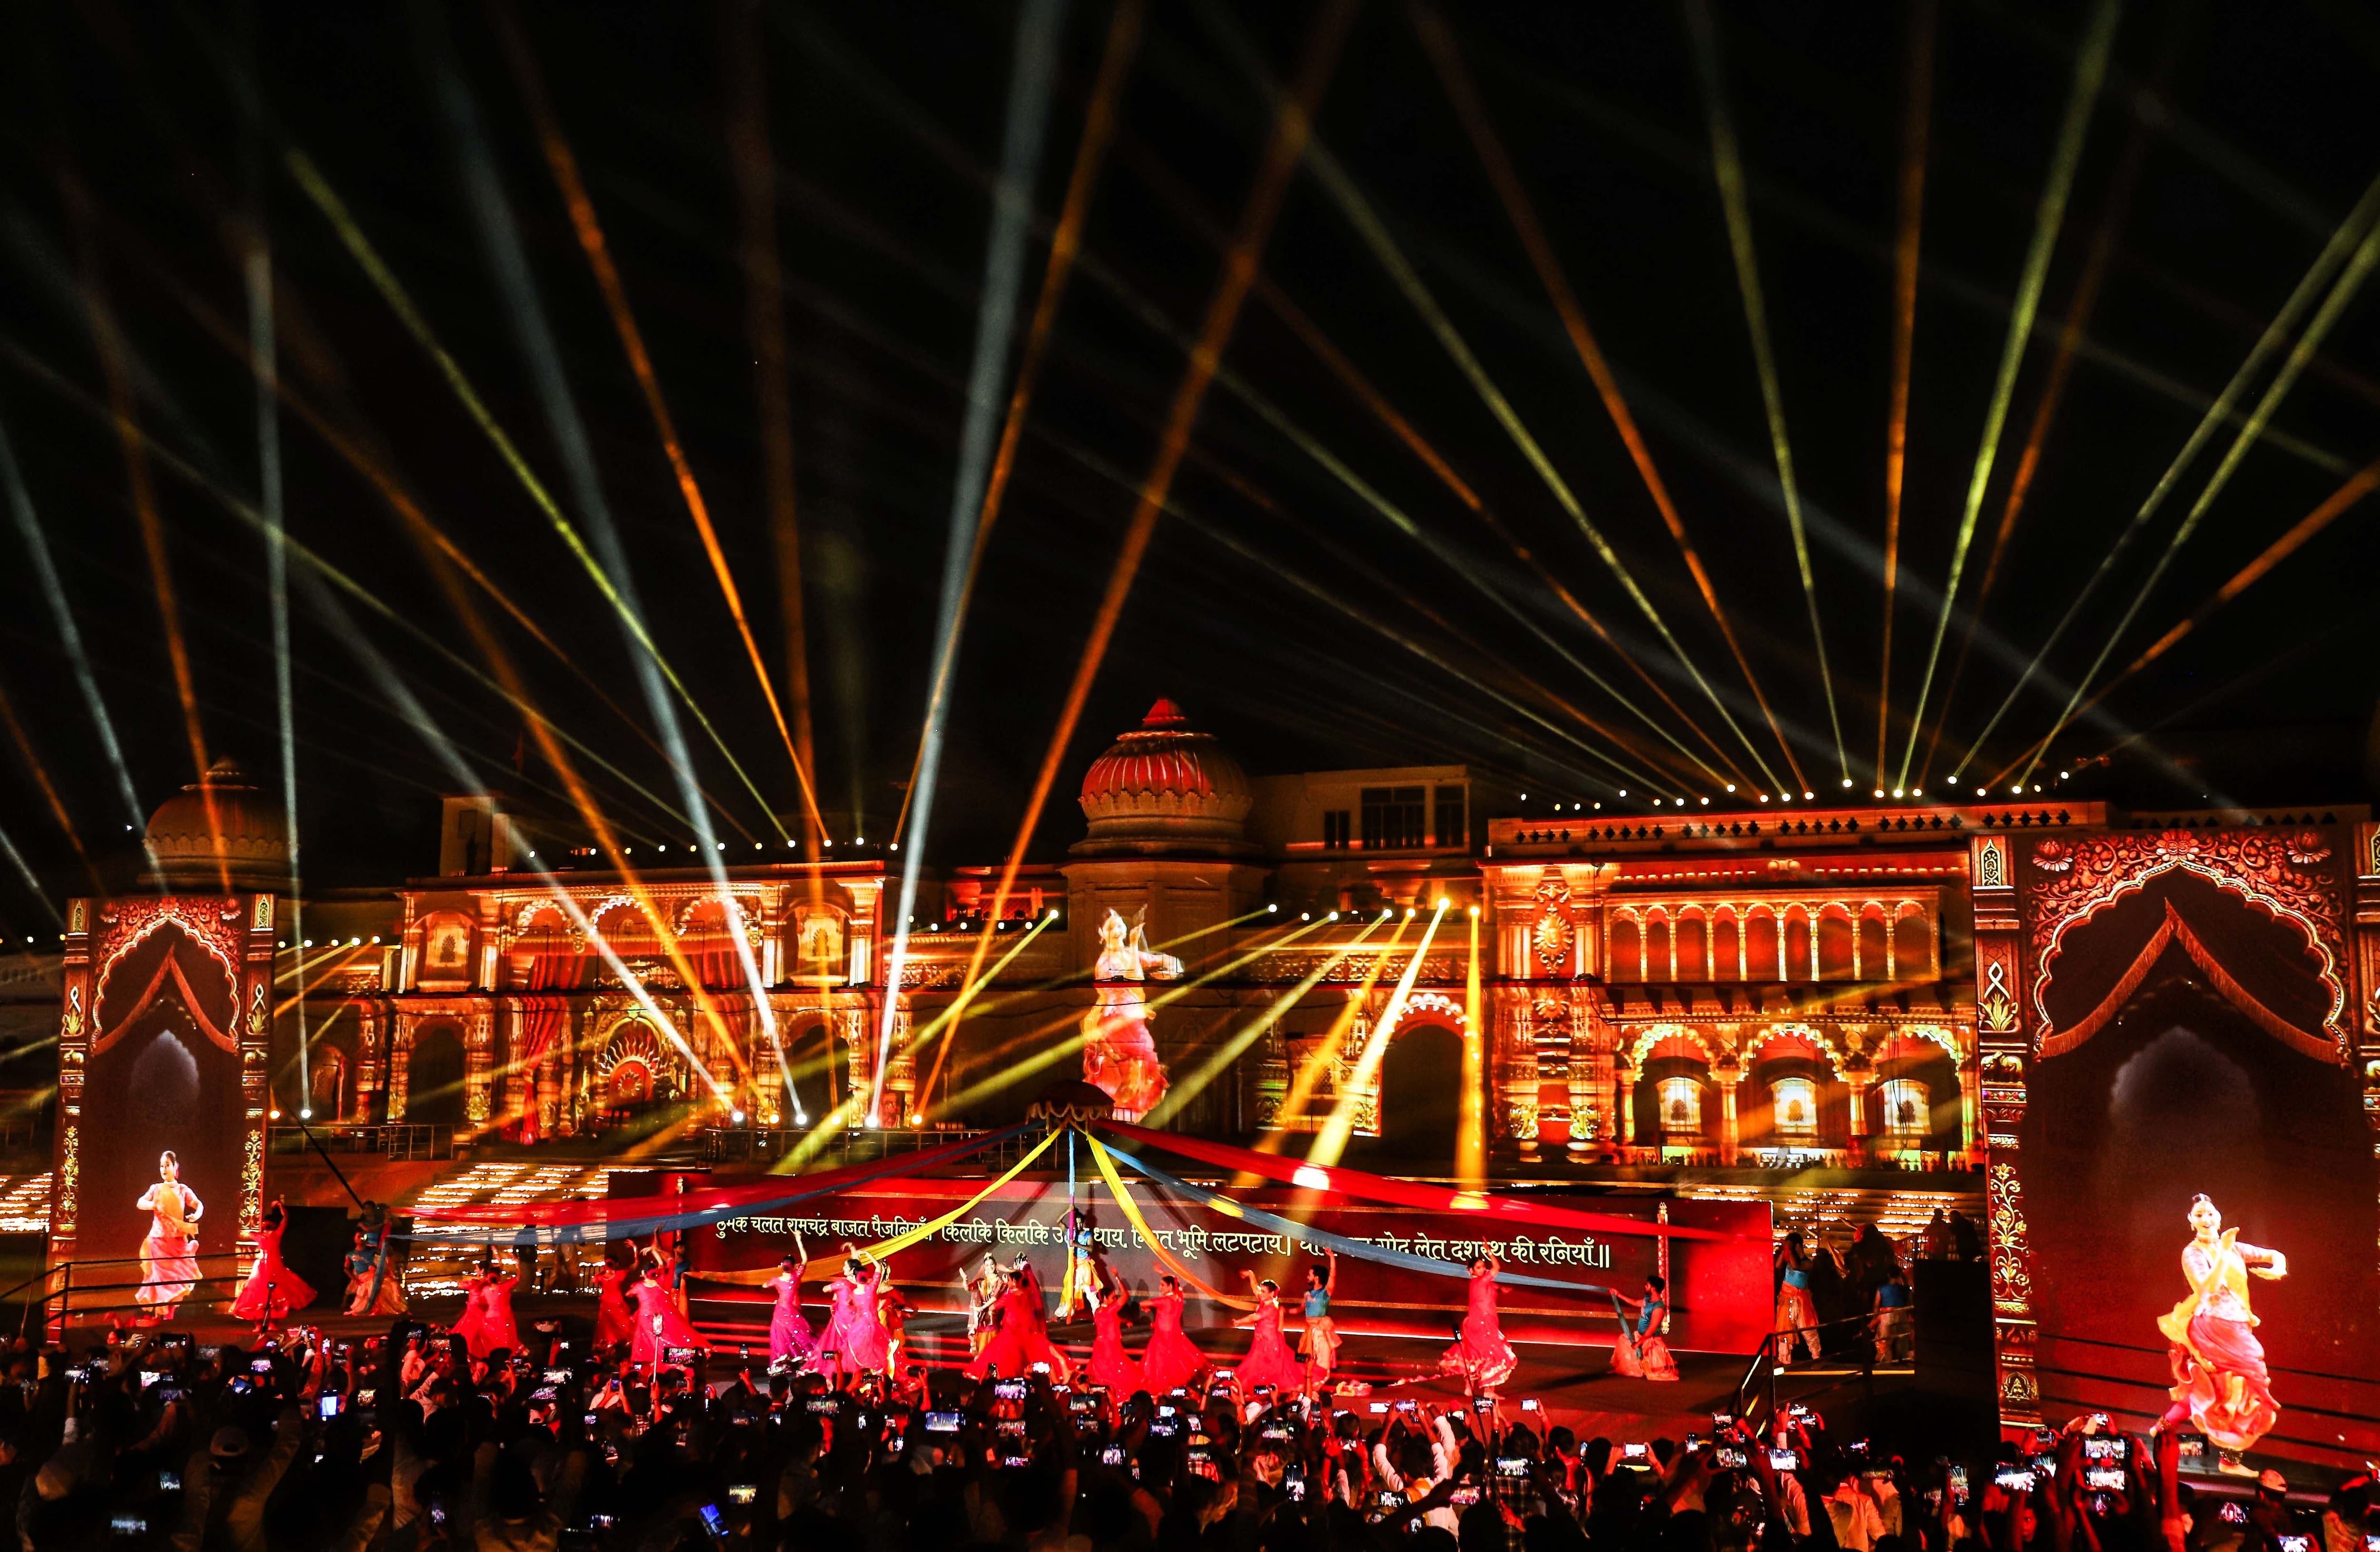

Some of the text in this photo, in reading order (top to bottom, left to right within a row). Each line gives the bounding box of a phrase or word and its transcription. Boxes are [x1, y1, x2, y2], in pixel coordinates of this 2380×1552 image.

[750, 1216, 787, 1234] चलत
[786, 1213, 829, 1236] रामचंद्र
[830, 1219, 872, 1237] बाजत
[995, 1218, 1050, 1245] किलकि
[1177, 1224, 1212, 1260] भूमि
[1414, 1232, 1451, 1261] लेत
[1450, 1240, 1511, 1263] दशरथ
[1510, 1236, 1540, 1264] की
